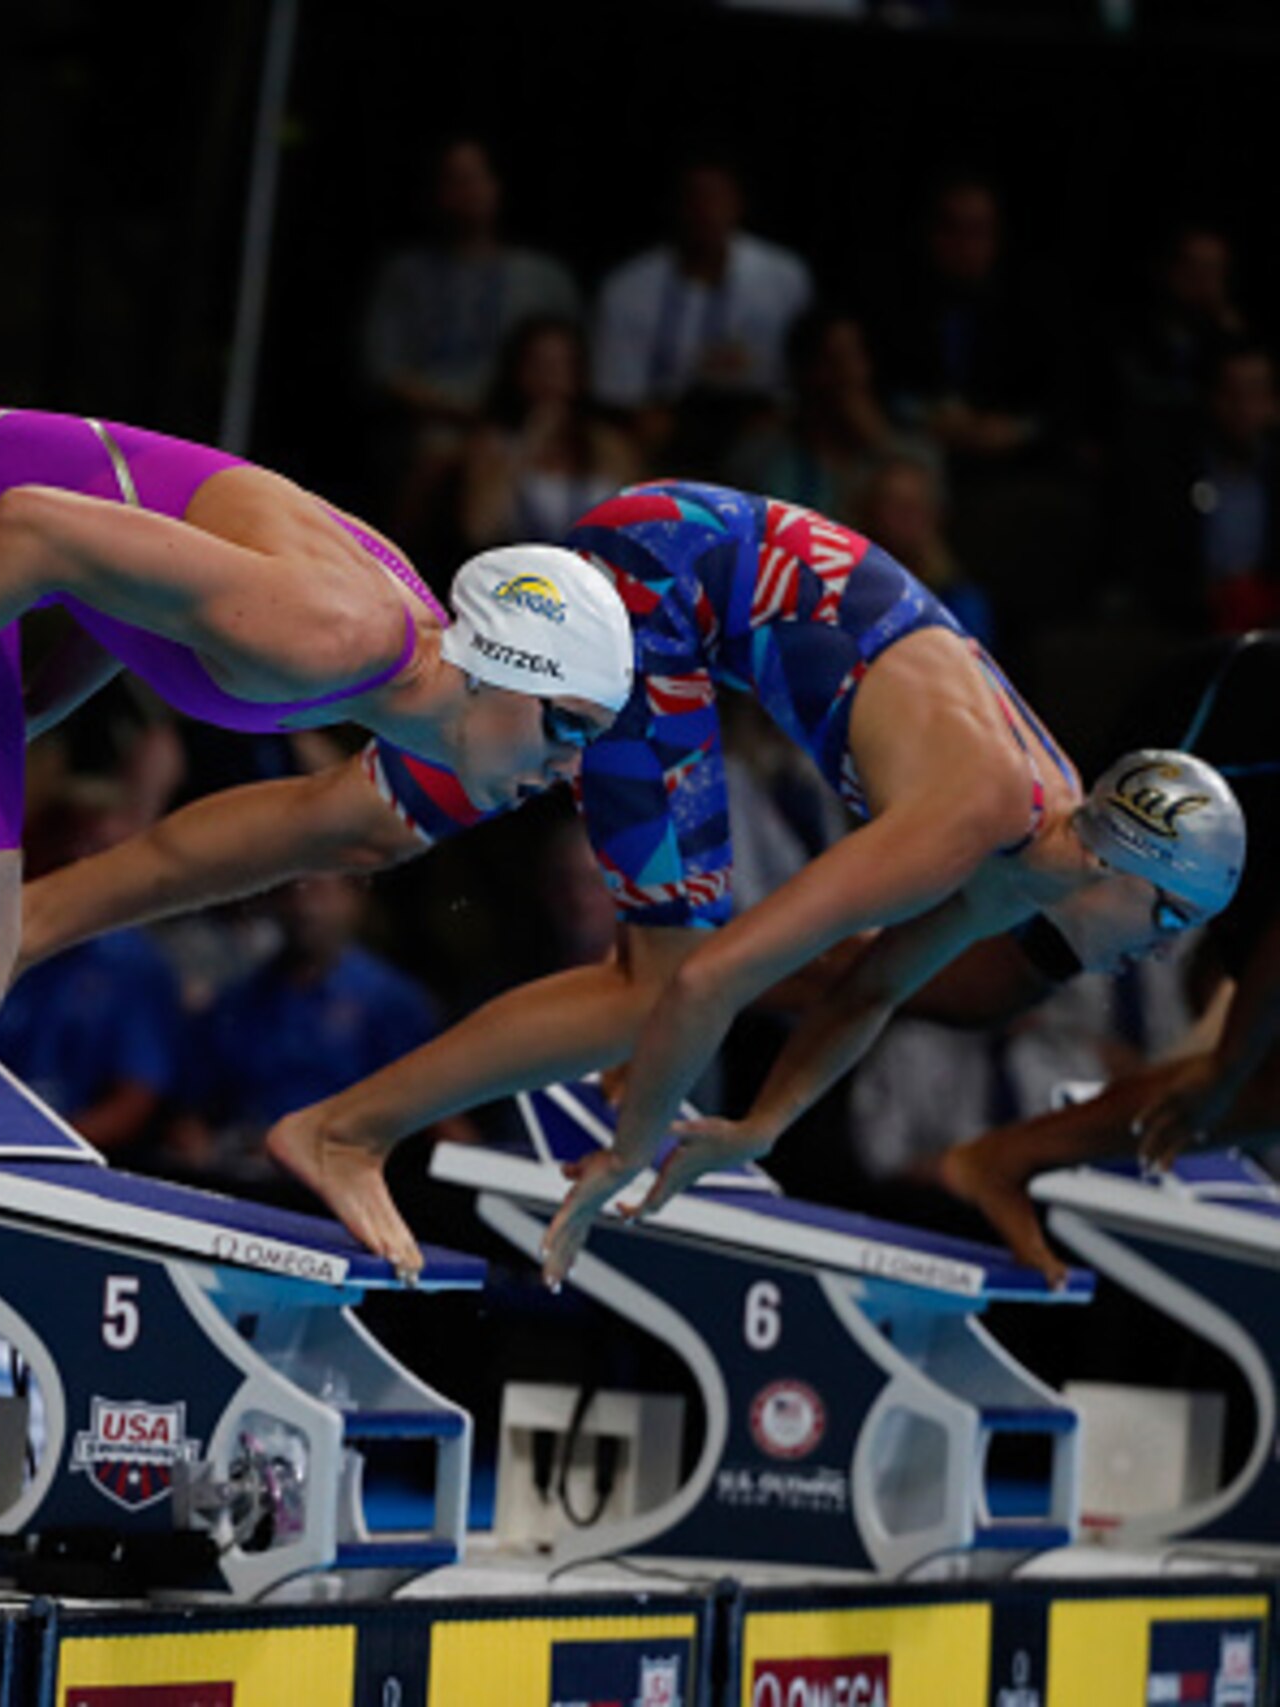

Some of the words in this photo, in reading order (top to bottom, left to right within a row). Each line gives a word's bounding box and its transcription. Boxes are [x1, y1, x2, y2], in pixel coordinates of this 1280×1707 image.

[1114, 761, 1211, 838] Cal
[245, 1241, 333, 1283] OMEGA
[102, 1275, 140, 1350] 5
[744, 1280, 782, 1351] 6
[102, 1413, 169, 1445] USA
